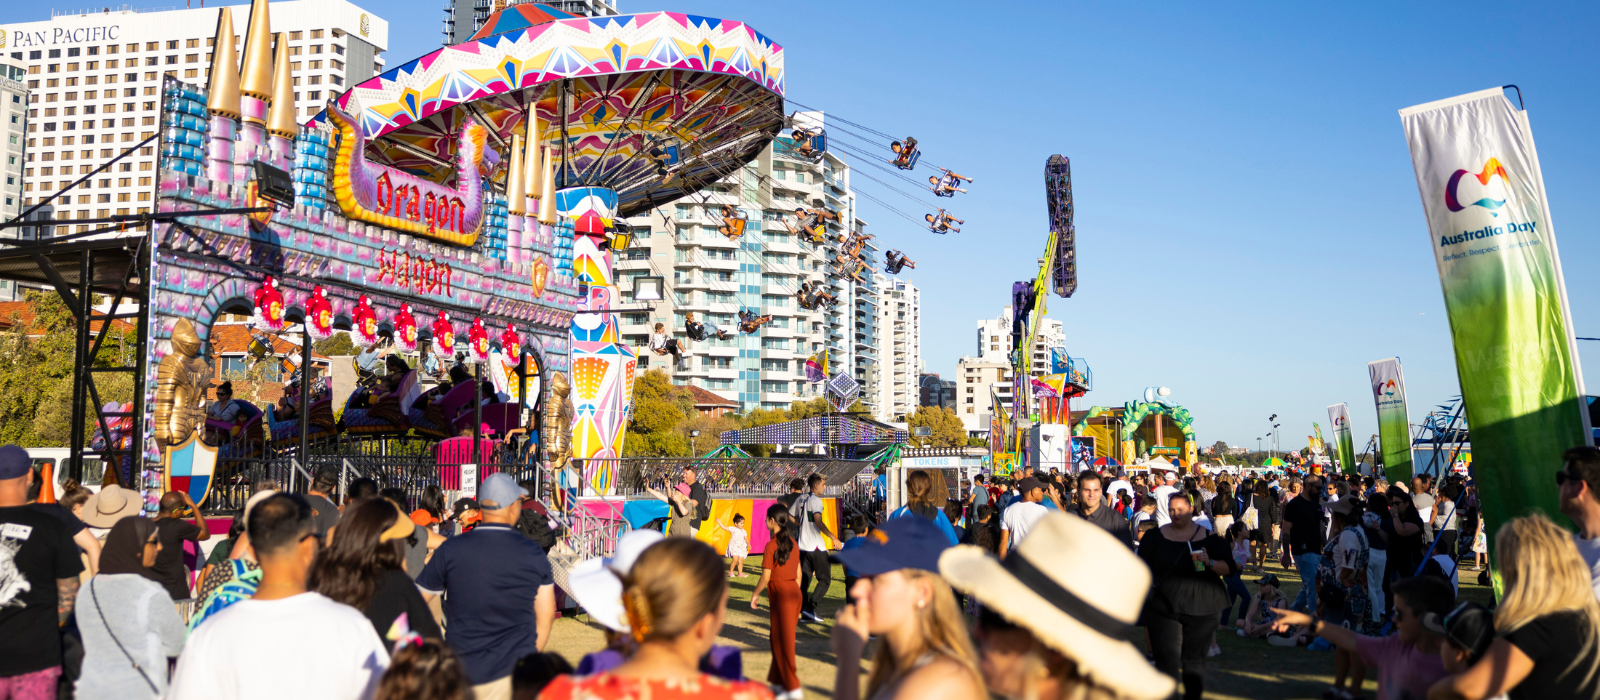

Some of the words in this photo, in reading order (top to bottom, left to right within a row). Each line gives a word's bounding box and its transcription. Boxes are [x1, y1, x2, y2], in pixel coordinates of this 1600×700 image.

[13, 31, 47, 47] PAN
[52, 25, 120, 44] PACIFIC
[1440, 226, 1504, 247] Australia
[1507, 221, 1536, 234] Day
[1442, 251, 1469, 262] Reflect.
[913, 458, 949, 466] TOKENS
